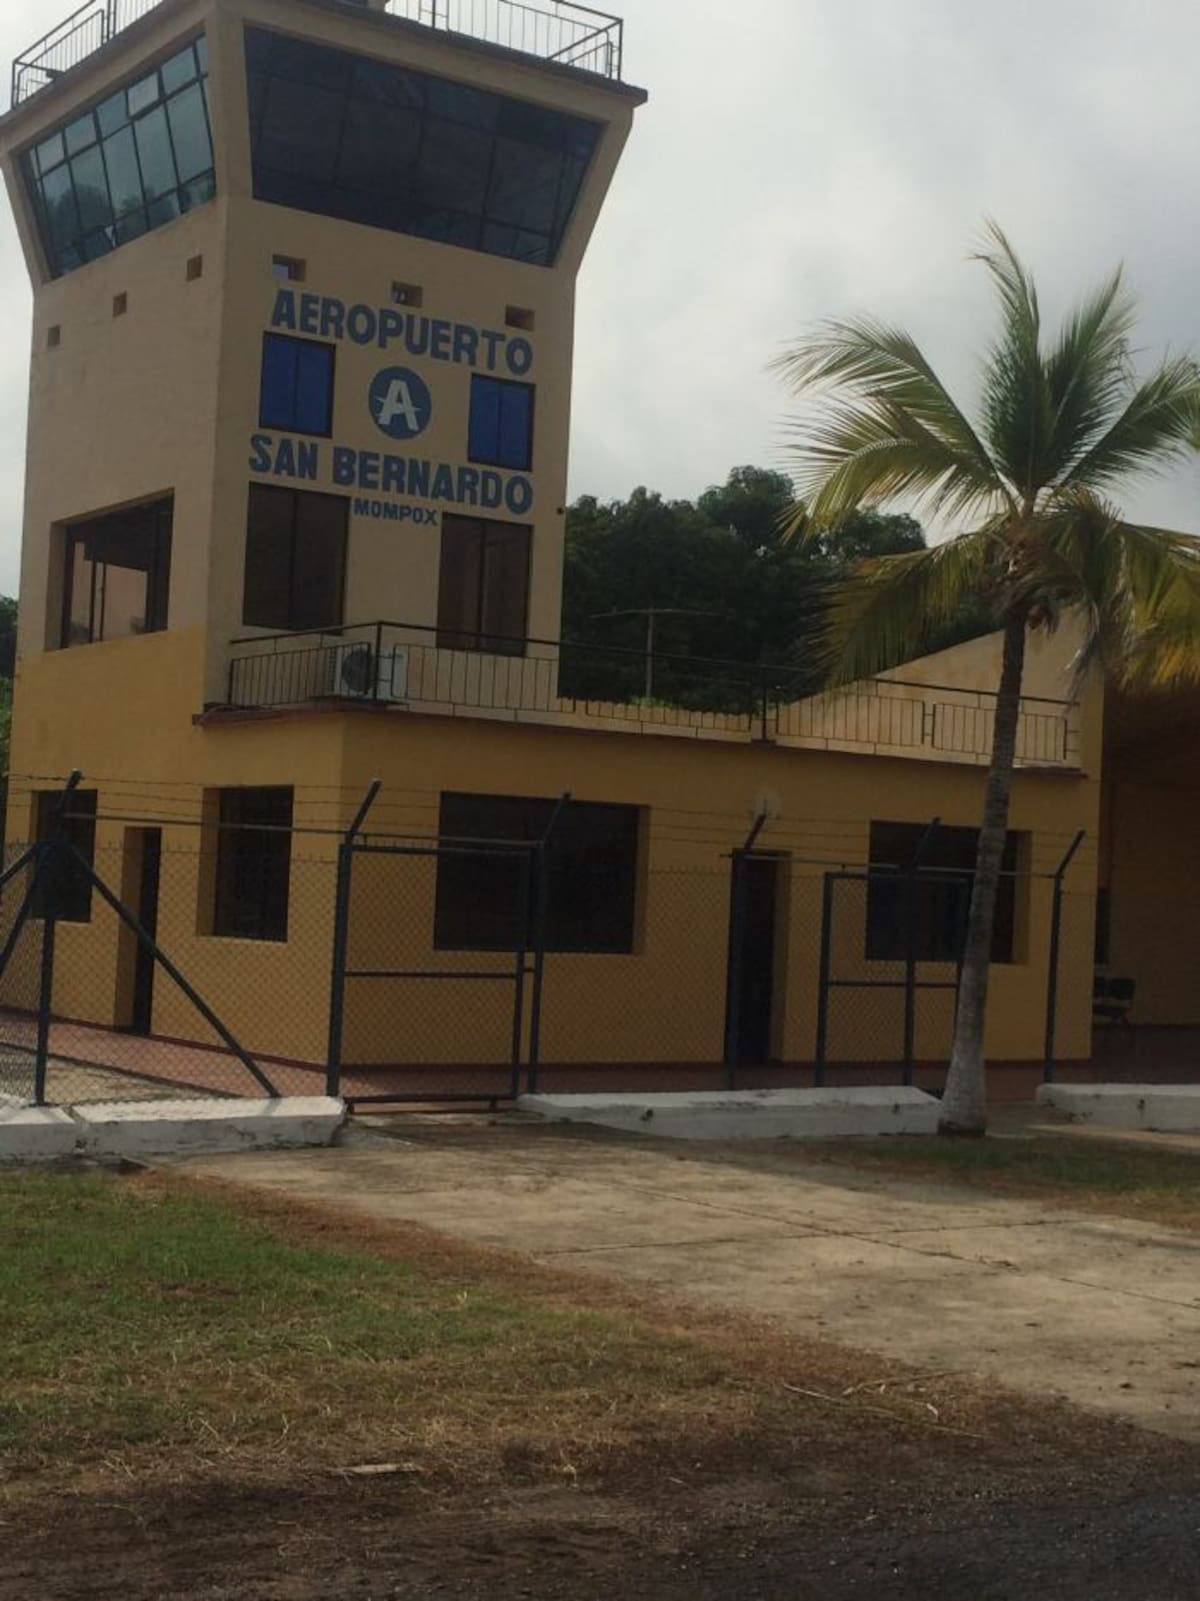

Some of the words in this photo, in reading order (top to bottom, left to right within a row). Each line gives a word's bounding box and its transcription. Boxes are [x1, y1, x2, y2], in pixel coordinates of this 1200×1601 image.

[271, 288, 533, 376] AEROPUERTO
[375, 379, 420, 431] A
[248, 433, 318, 480] SAN
[332, 446, 533, 515] BERNARDO
[354, 497, 438, 525] MOMPOX
